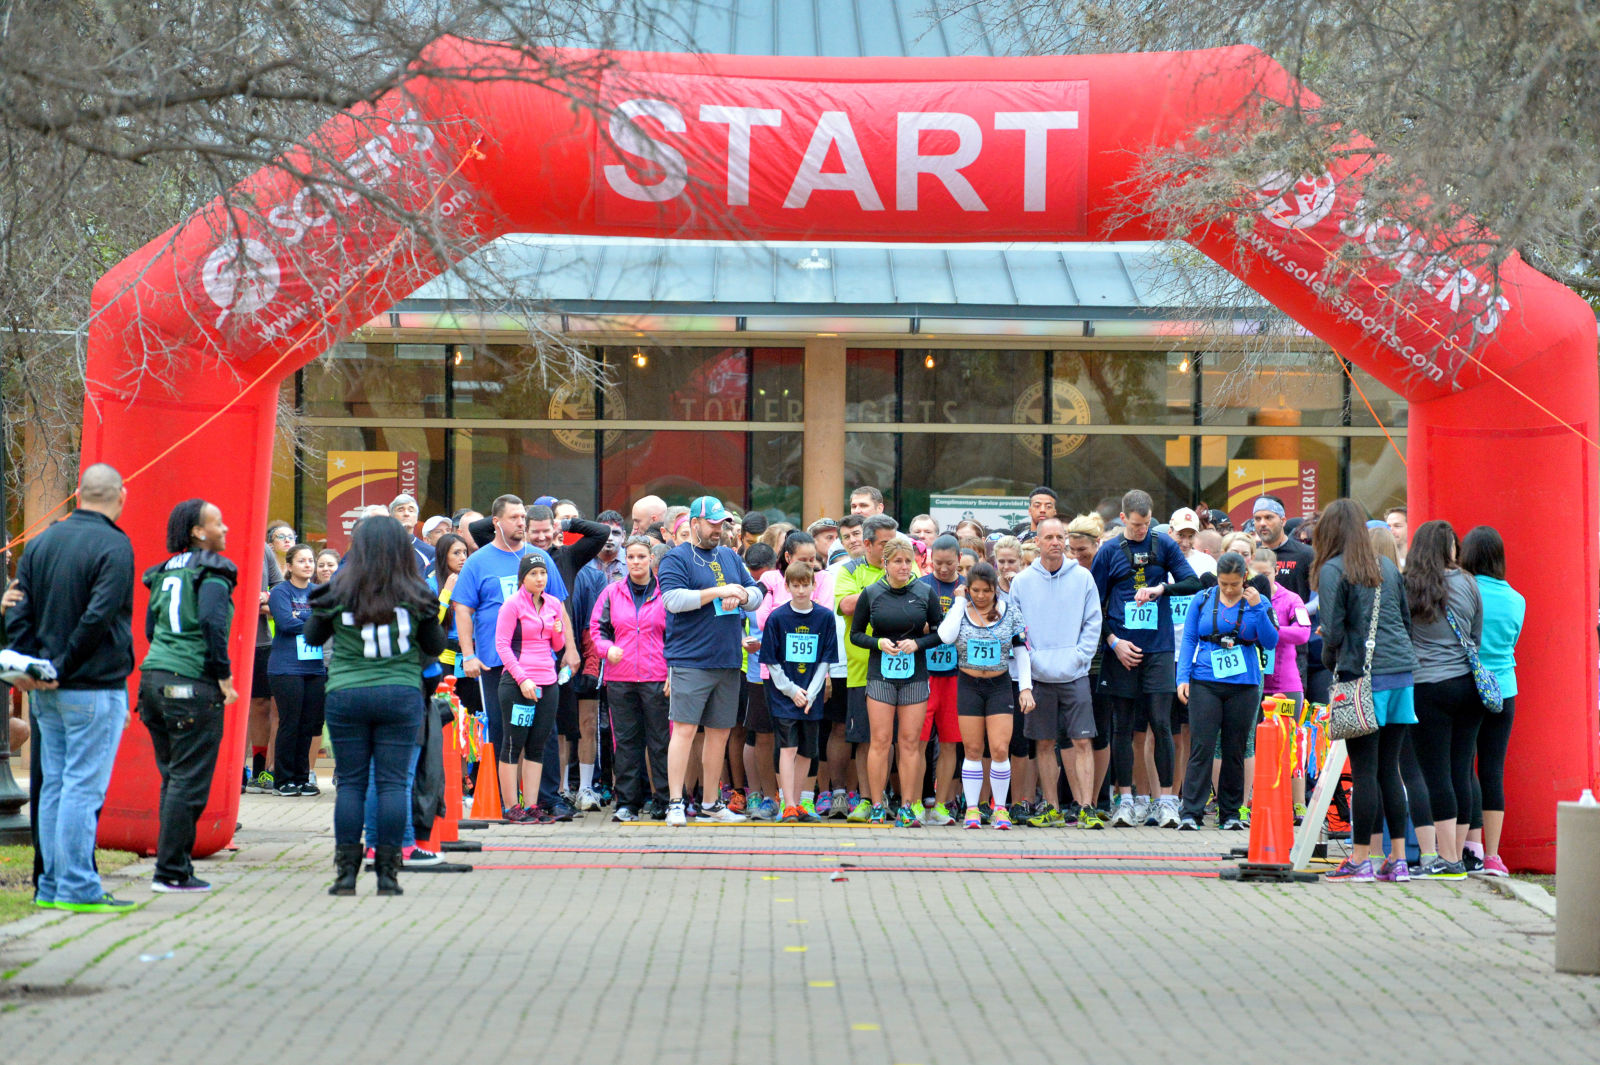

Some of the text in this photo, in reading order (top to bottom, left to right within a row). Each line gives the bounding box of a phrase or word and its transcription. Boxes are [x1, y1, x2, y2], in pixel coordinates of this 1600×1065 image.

[603, 98, 1079, 212] START
[161, 576, 182, 633] 7
[1130, 608, 1152, 622] 707
[791, 641, 813, 655] 595
[973, 646, 995, 659] 751
[887, 657, 909, 671] 726
[930, 650, 952, 664] 478
[1216, 653, 1239, 671] 783
